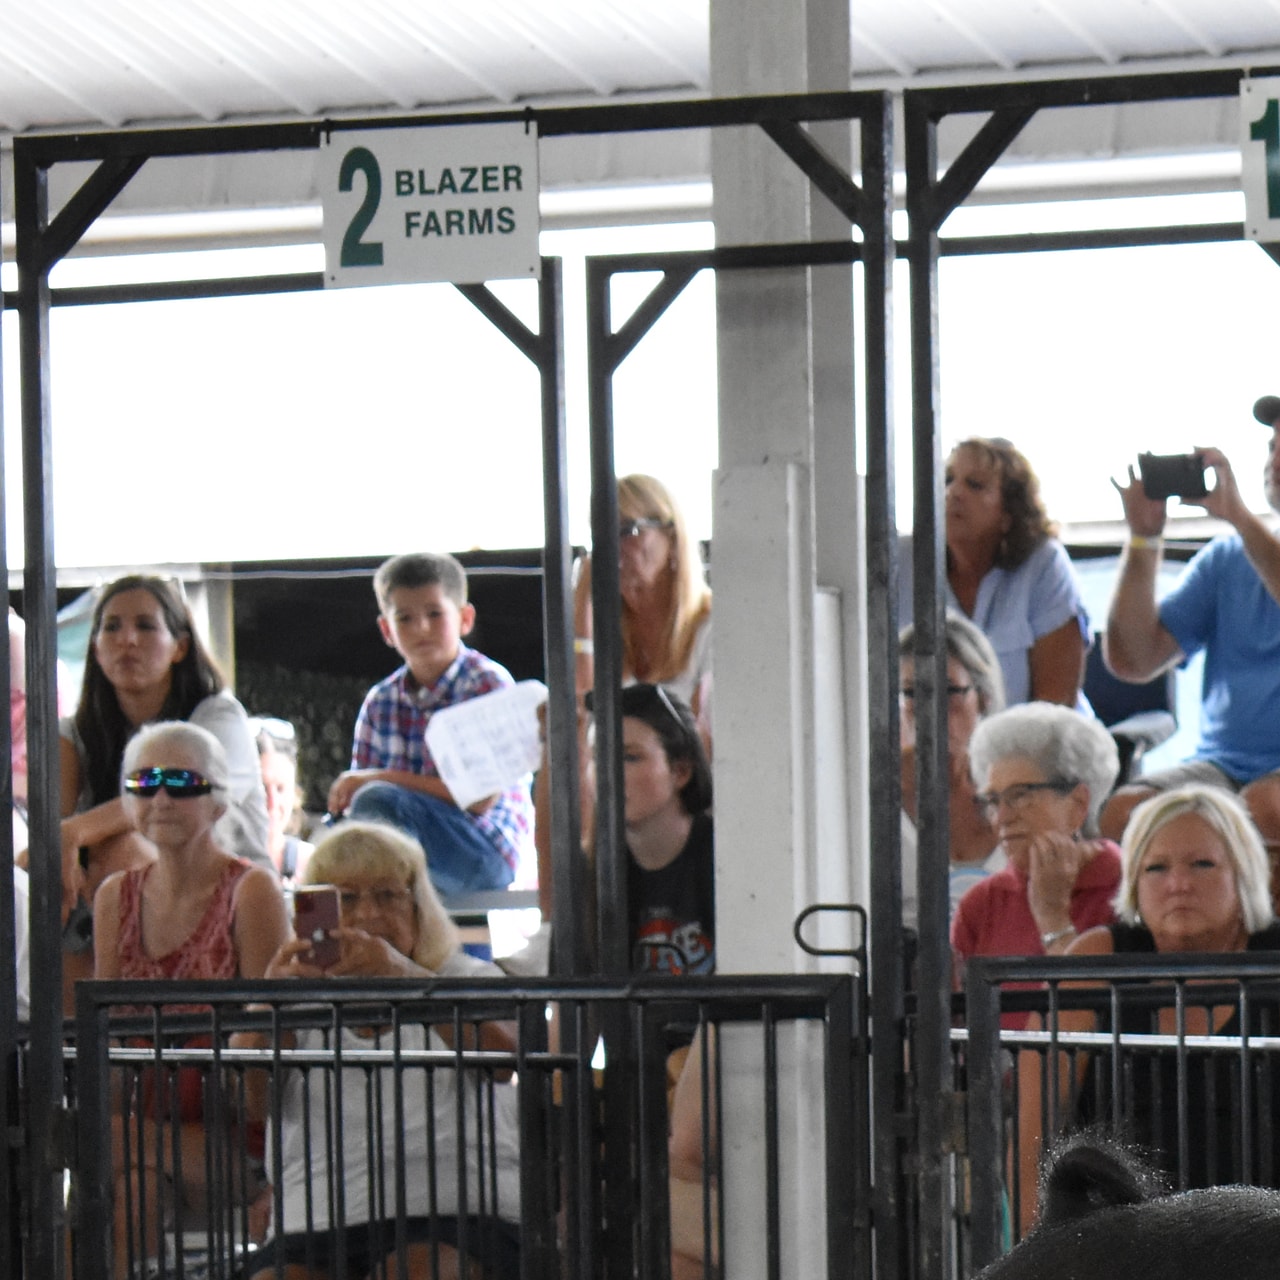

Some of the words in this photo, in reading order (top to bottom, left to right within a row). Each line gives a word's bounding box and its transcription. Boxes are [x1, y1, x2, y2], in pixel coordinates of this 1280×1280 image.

[394, 165, 523, 197] BLAZER
[338, 146, 384, 268] 2
[404, 206, 516, 238] FARMS
